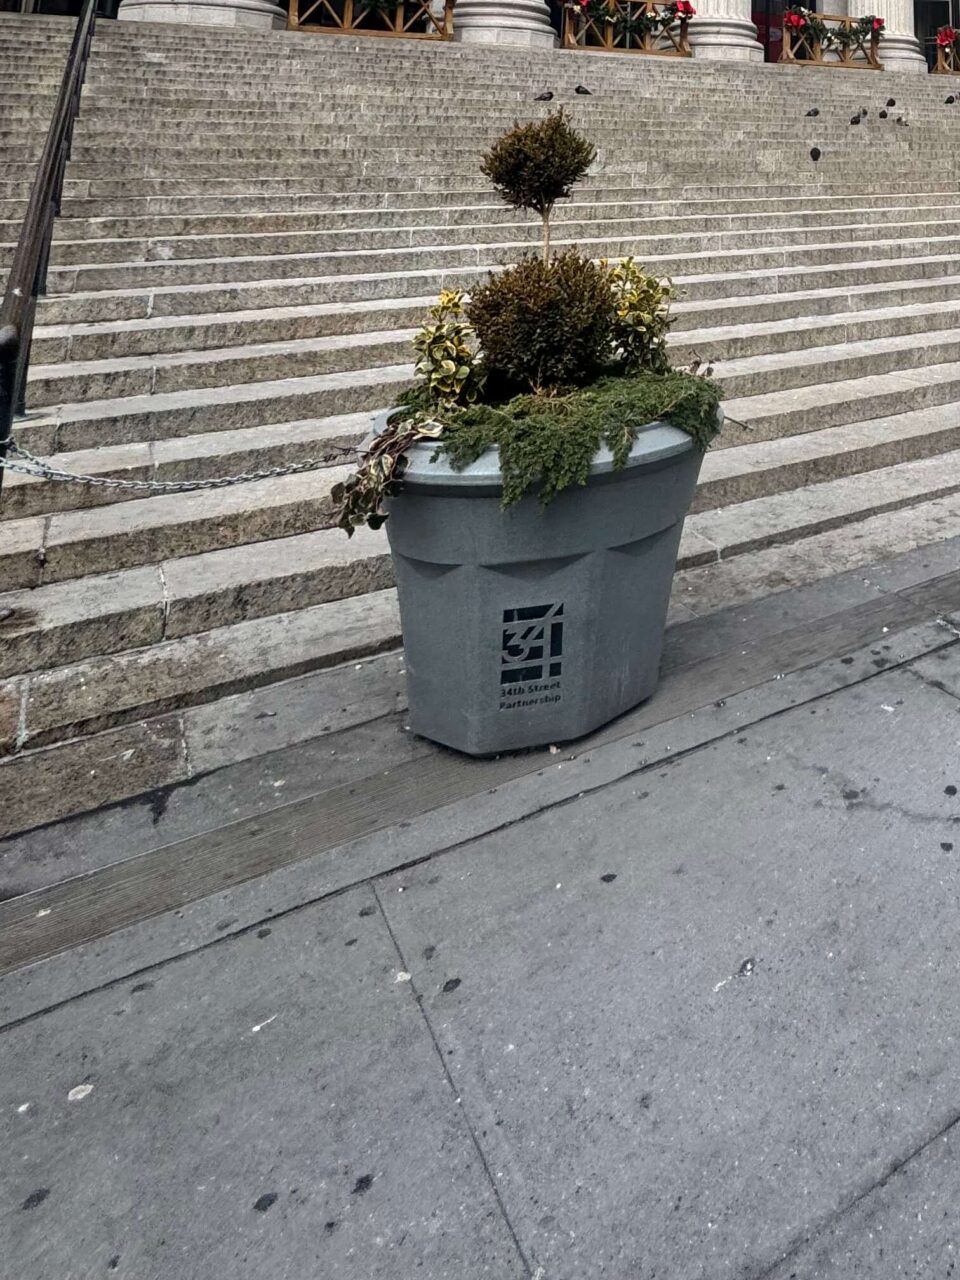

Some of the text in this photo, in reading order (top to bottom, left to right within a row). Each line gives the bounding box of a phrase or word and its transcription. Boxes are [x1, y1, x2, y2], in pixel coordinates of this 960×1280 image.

[500, 681, 562, 699] 34th Street
[499, 694, 562, 711] Partnership
